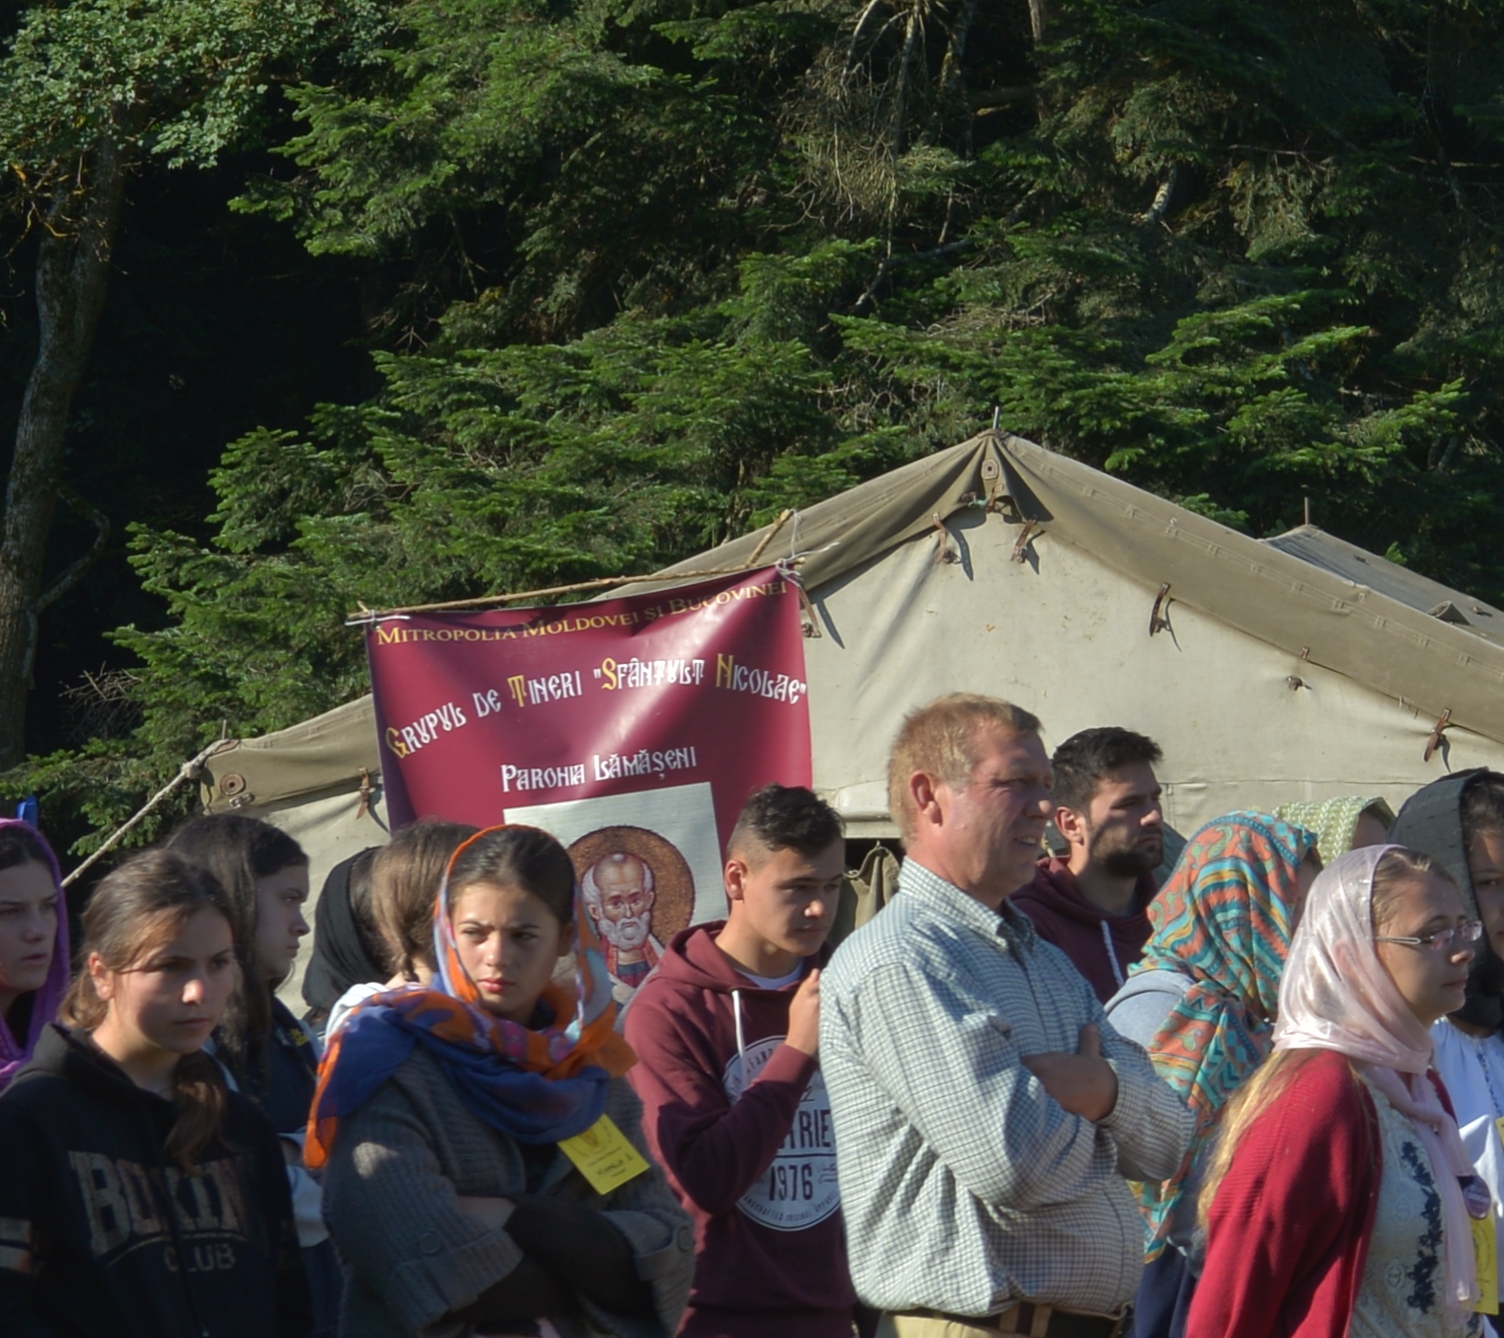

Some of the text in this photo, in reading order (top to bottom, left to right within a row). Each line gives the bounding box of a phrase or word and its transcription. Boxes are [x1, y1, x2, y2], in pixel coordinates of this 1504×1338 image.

[377, 627, 517, 645] MITROPOLIA
[522, 612, 638, 638] MOLDOVEI
[669, 581, 787, 614] BUCOVINEI
[472, 689, 501, 718] DE
[769, 1164, 813, 1201] 1976
